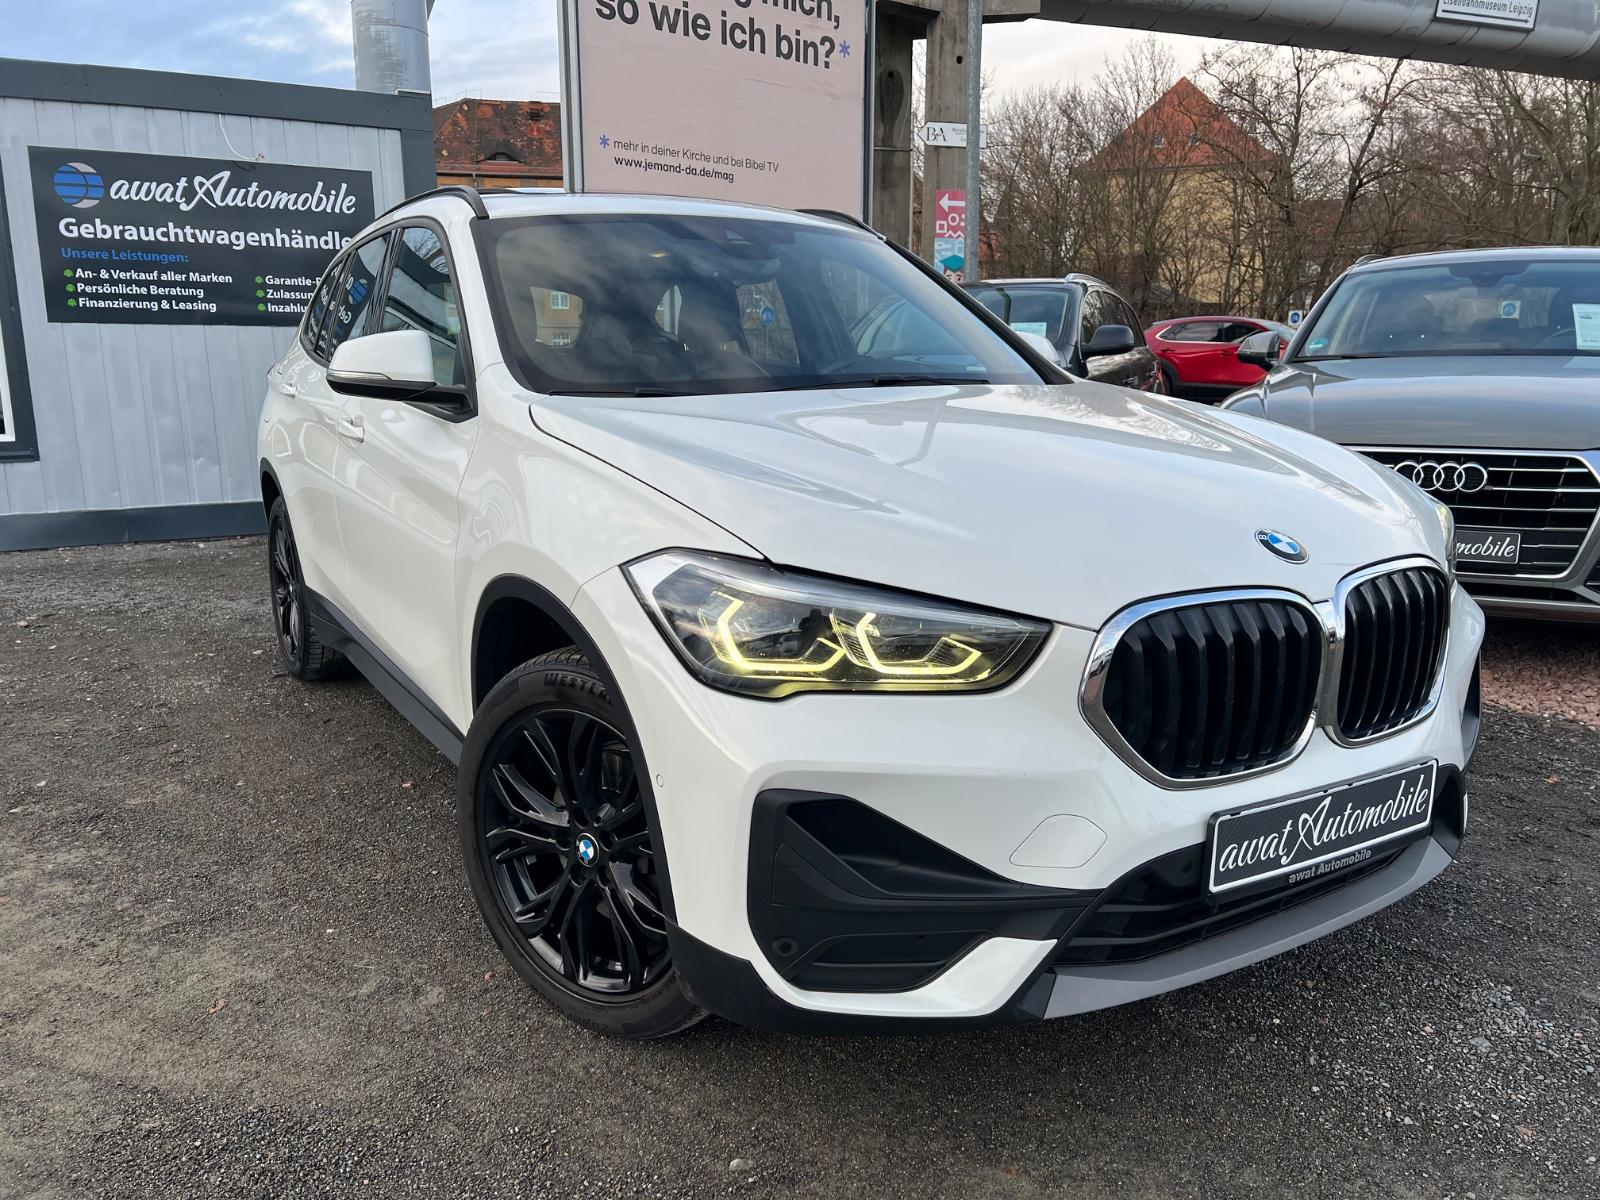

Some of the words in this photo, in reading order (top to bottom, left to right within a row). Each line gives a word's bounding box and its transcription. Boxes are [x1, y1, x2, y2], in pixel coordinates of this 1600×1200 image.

[760, 0, 840, 29] ch,
[1509, 1, 1534, 17] Leipzig
[596, 0, 639, 25] so
[648, 1, 711, 41] wie
[720, 10, 766, 54] ich
[613, 140, 639, 152] mehr
[641, 142, 650, 153] in
[651, 144, 680, 158] deiner
[682, 148, 711, 162] Kirche
[713, 155, 729, 165] und
[730, 156, 744, 168] bei
[745, 158, 766, 171] Bibel
[767, 161, 779, 172] TV
[613, 156, 734, 183] www.jemand-da.de/mag
[60, 247, 109, 260] Unsere
[111, 249, 189, 264] Leistungen:
[75, 268, 97, 279] An-
[99, 269, 109, 279] &
[110, 269, 159, 281] Verkauf
[160, 271, 186, 282] aller
[189, 272, 233, 283] Marken
[77, 283, 148, 295] Persönliche
[150, 285, 204, 298] Beratung
[78, 297, 158, 311] Finanzierung
[160, 300, 170, 310] &
[172, 300, 217, 313] Leasing
[1288, 867, 1317, 884] awat
[1316, 848, 1372, 877] Automobile
